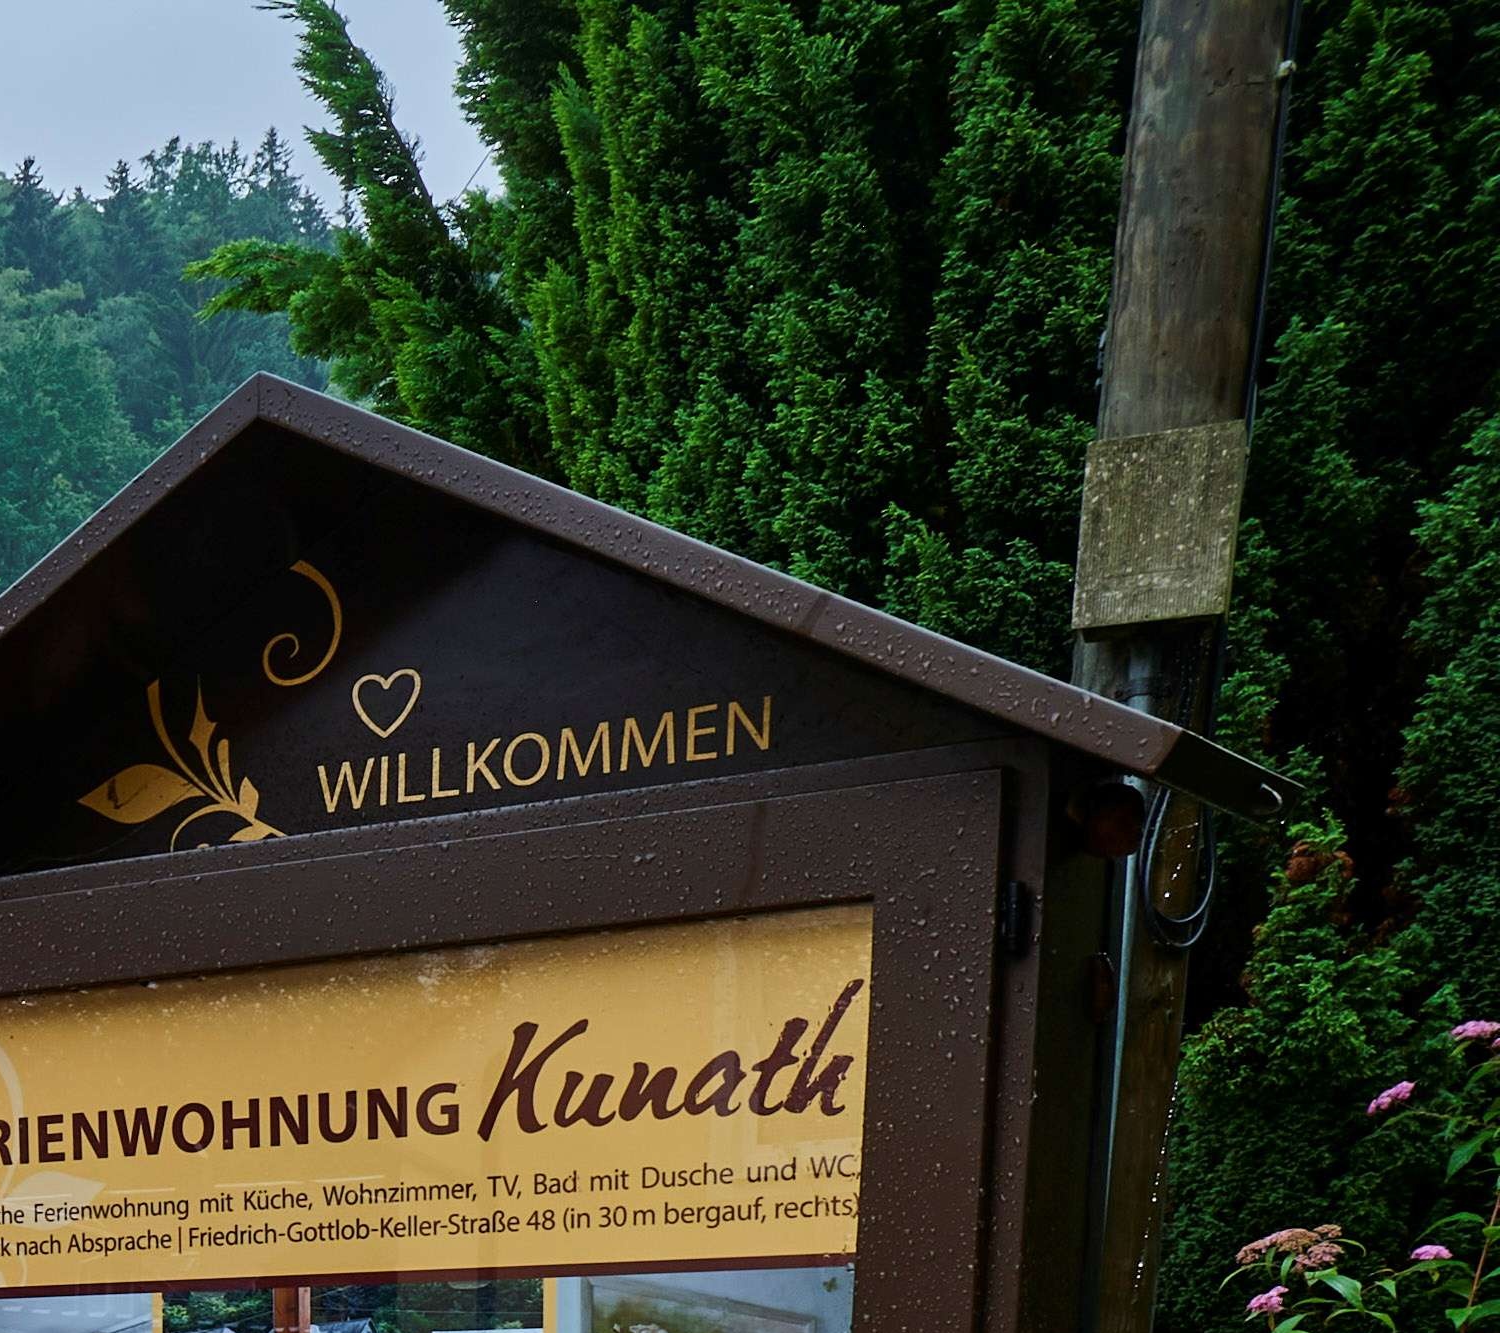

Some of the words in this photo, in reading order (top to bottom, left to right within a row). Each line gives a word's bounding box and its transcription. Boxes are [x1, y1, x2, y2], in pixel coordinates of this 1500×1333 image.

[318, 695, 771, 813] WILLKOMMEN
[477, 978, 865, 1141] Kunath
[16, 1234, 62, 1257] nach
[66, 1231, 172, 1260] Absprache
[188, 1210, 520, 1248] Friedrich-Gottlob-Keller-Straße
[525, 1209, 556, 1232] 48
[562, 1206, 592, 1234] (in
[598, 1205, 628, 1229] 30
[632, 1209, 656, 1227] m
[663, 1195, 767, 1230] bergauf,
[774, 1189, 860, 1220] rechts)
[33, 1196, 190, 1224] Ferienwohnung
[200, 1193, 234, 1214] mit
[243, 1187, 313, 1212] Küche,
[322, 1182, 478, 1206] Wohnzimmer,
[487, 1174, 522, 1200] TV,
[533, 1170, 578, 1196] Bad
[590, 1169, 629, 1192] mit
[641, 1162, 734, 1189] Dusche
[746, 1156, 797, 1183] und
